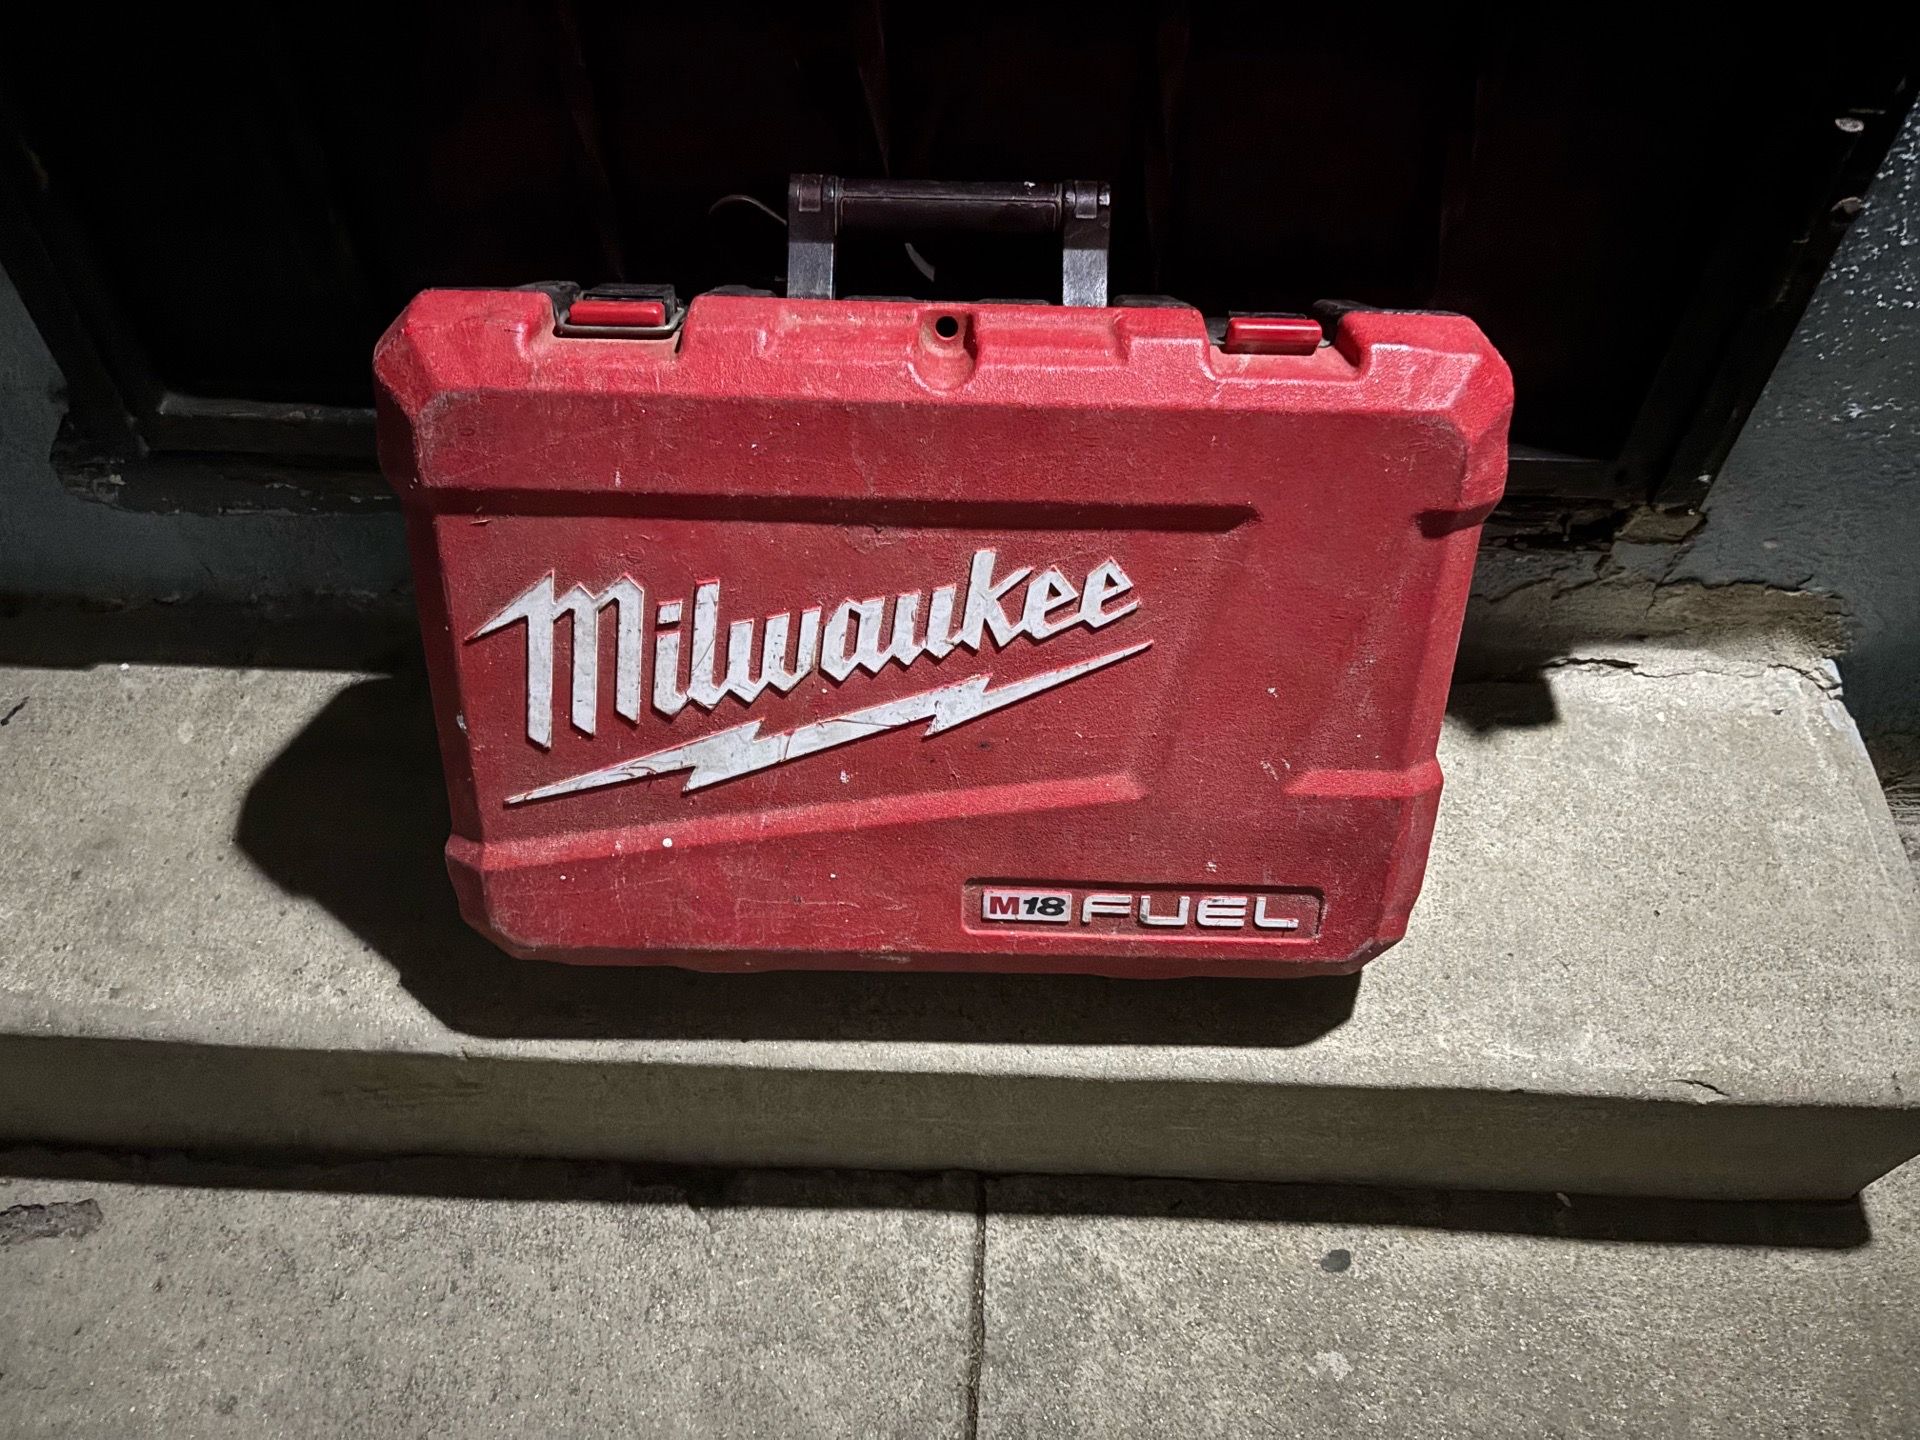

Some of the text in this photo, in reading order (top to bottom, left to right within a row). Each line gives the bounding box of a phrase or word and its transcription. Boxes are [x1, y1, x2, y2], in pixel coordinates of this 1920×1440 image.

[464, 547, 1140, 750] Milwaukee
[988, 893, 1299, 929] M18 FUEL
